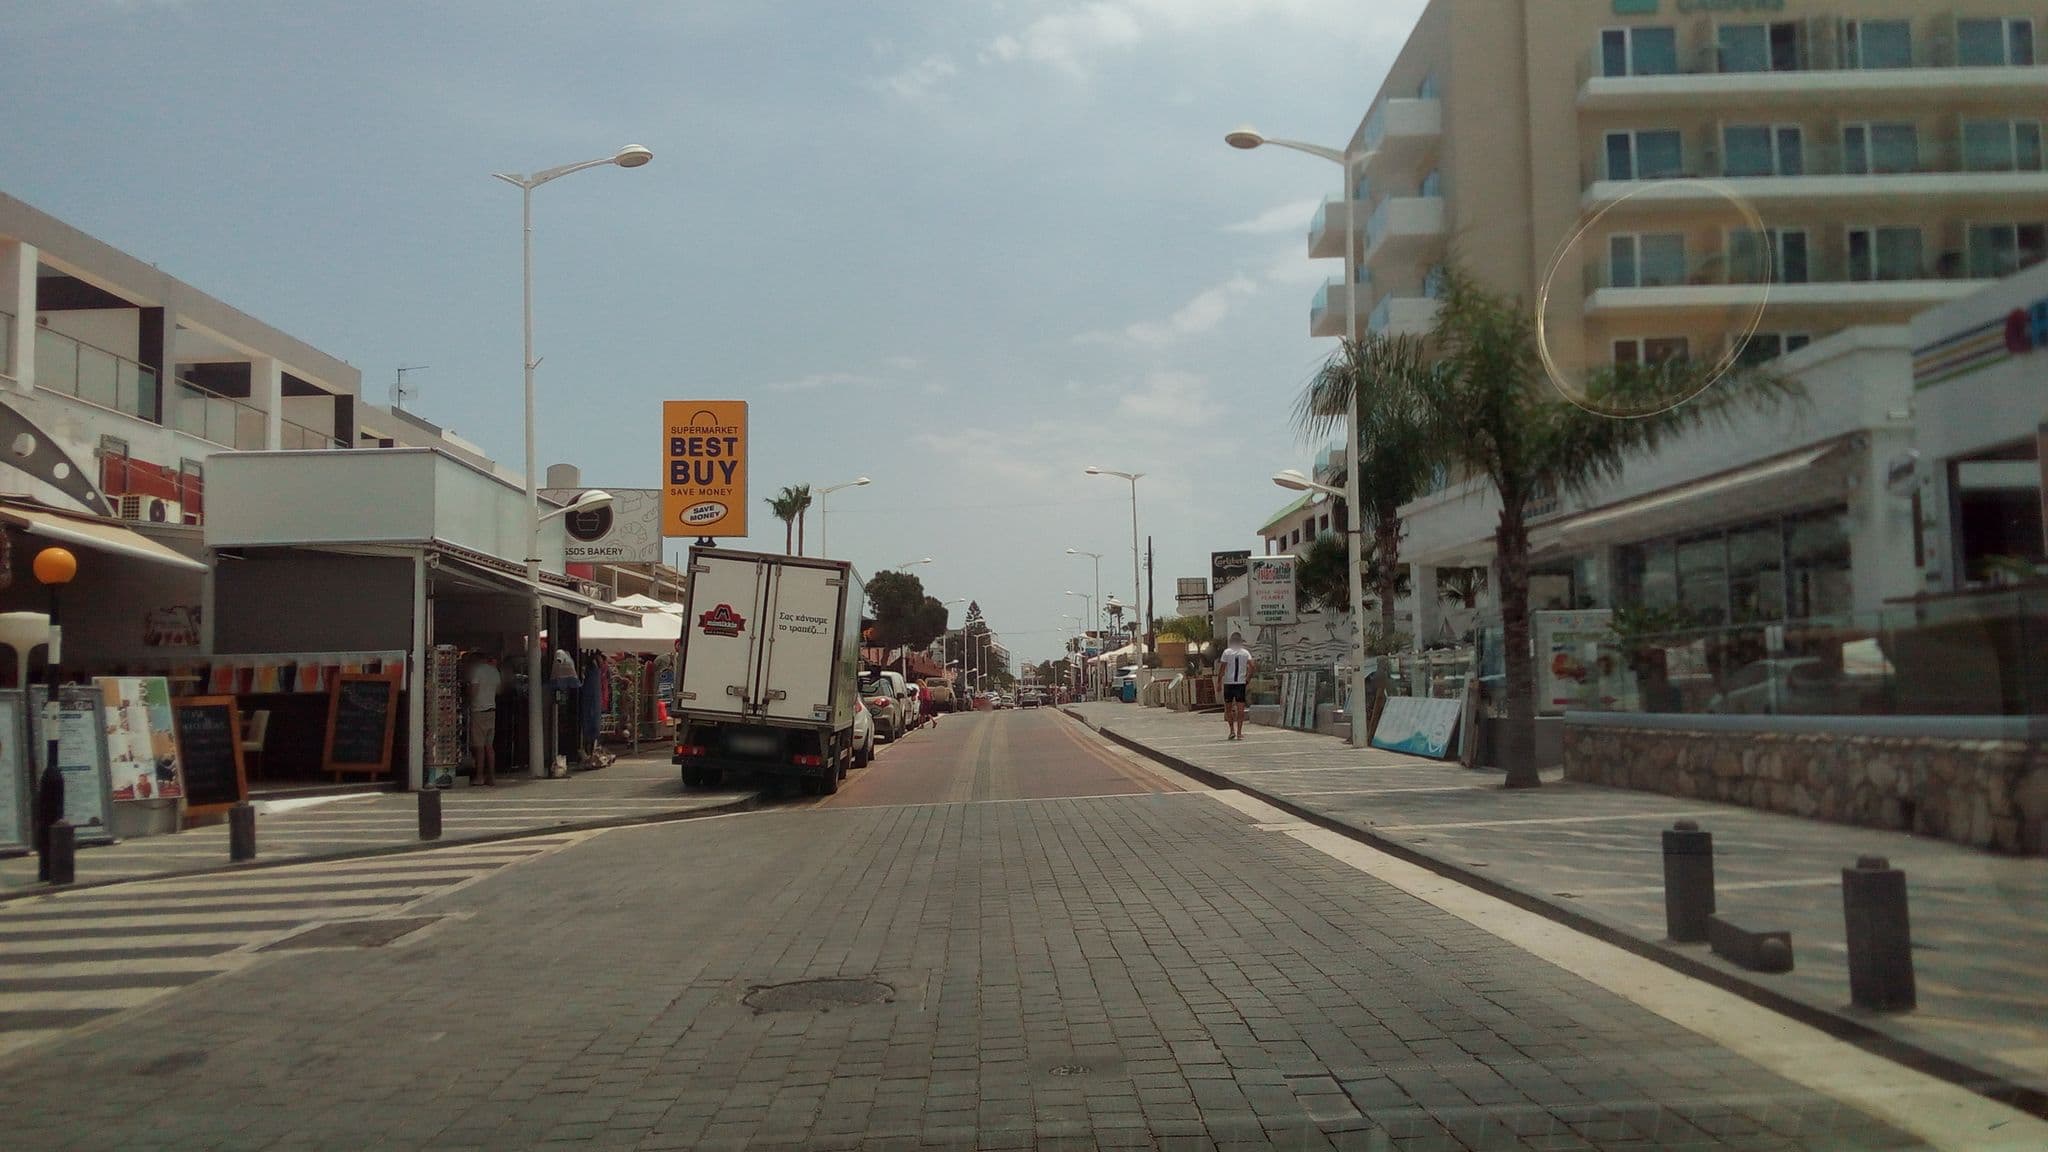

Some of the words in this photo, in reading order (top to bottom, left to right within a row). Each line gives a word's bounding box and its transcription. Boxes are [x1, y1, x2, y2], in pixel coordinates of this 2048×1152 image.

[671, 426, 738, 434] SUPERMARKET
[671, 437, 738, 457] BEST
[671, 460, 738, 485] BUY
[671, 488, 694, 496] SAVE
[698, 488, 733, 496] MONEY
[693, 504, 715, 515] SAVE
[689, 510, 721, 521] MONEY
[587, 547, 624, 556] BAKERY
[779, 611, 794, 622] Σας
[795, 614, 828, 625] κάνουμε
